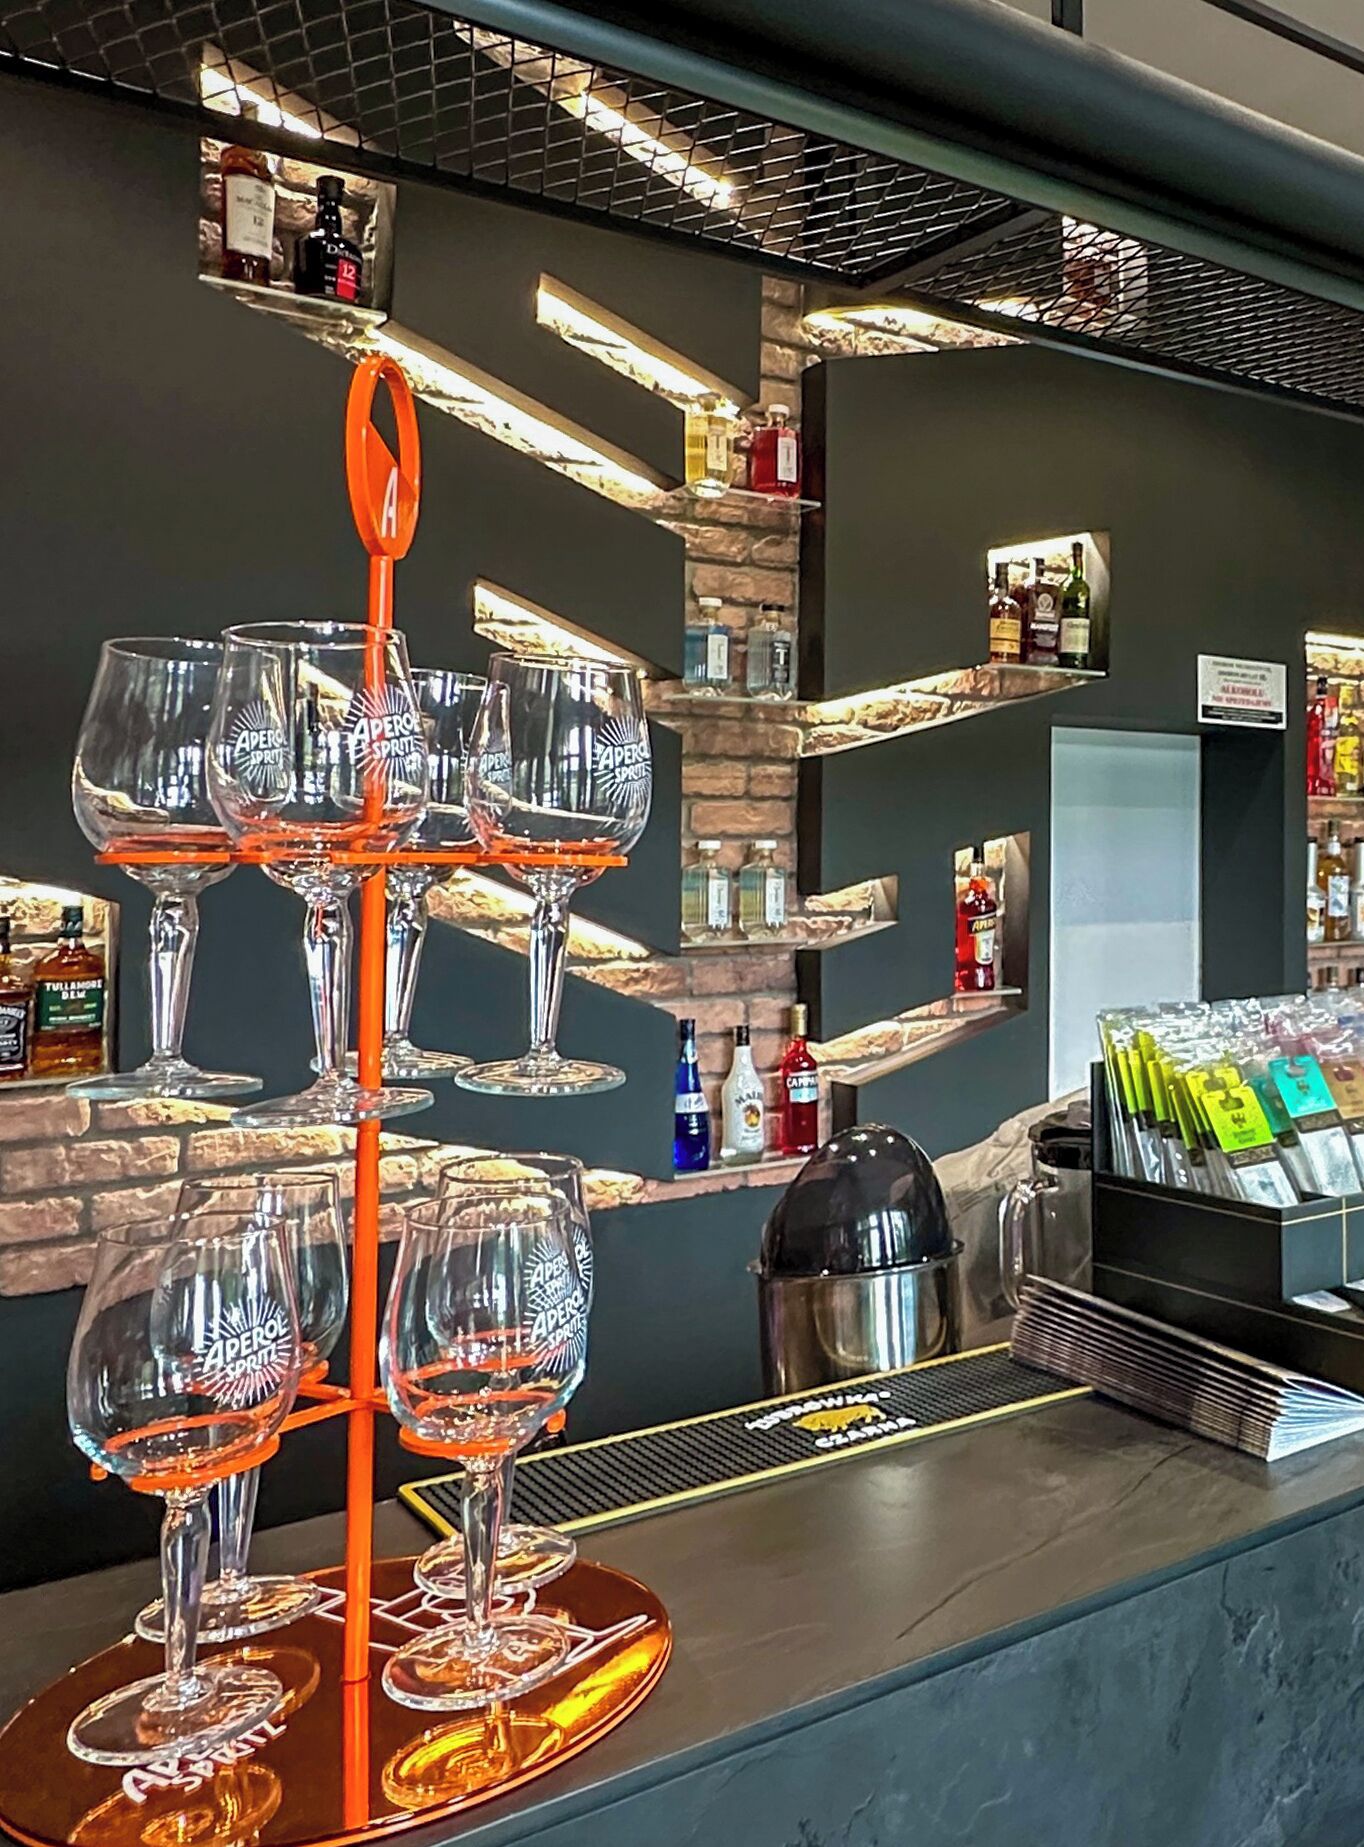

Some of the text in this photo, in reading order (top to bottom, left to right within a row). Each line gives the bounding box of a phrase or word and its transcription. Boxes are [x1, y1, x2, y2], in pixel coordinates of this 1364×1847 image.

[342, 263, 356, 280] 12
[381, 465, 398, 539] A
[44, 979, 103, 991] TULLAMORE
[202, 1312, 288, 1374] APEROL
[224, 1342, 278, 1383] SPRITZ
[814, 1416, 917, 1449] CZARNA
